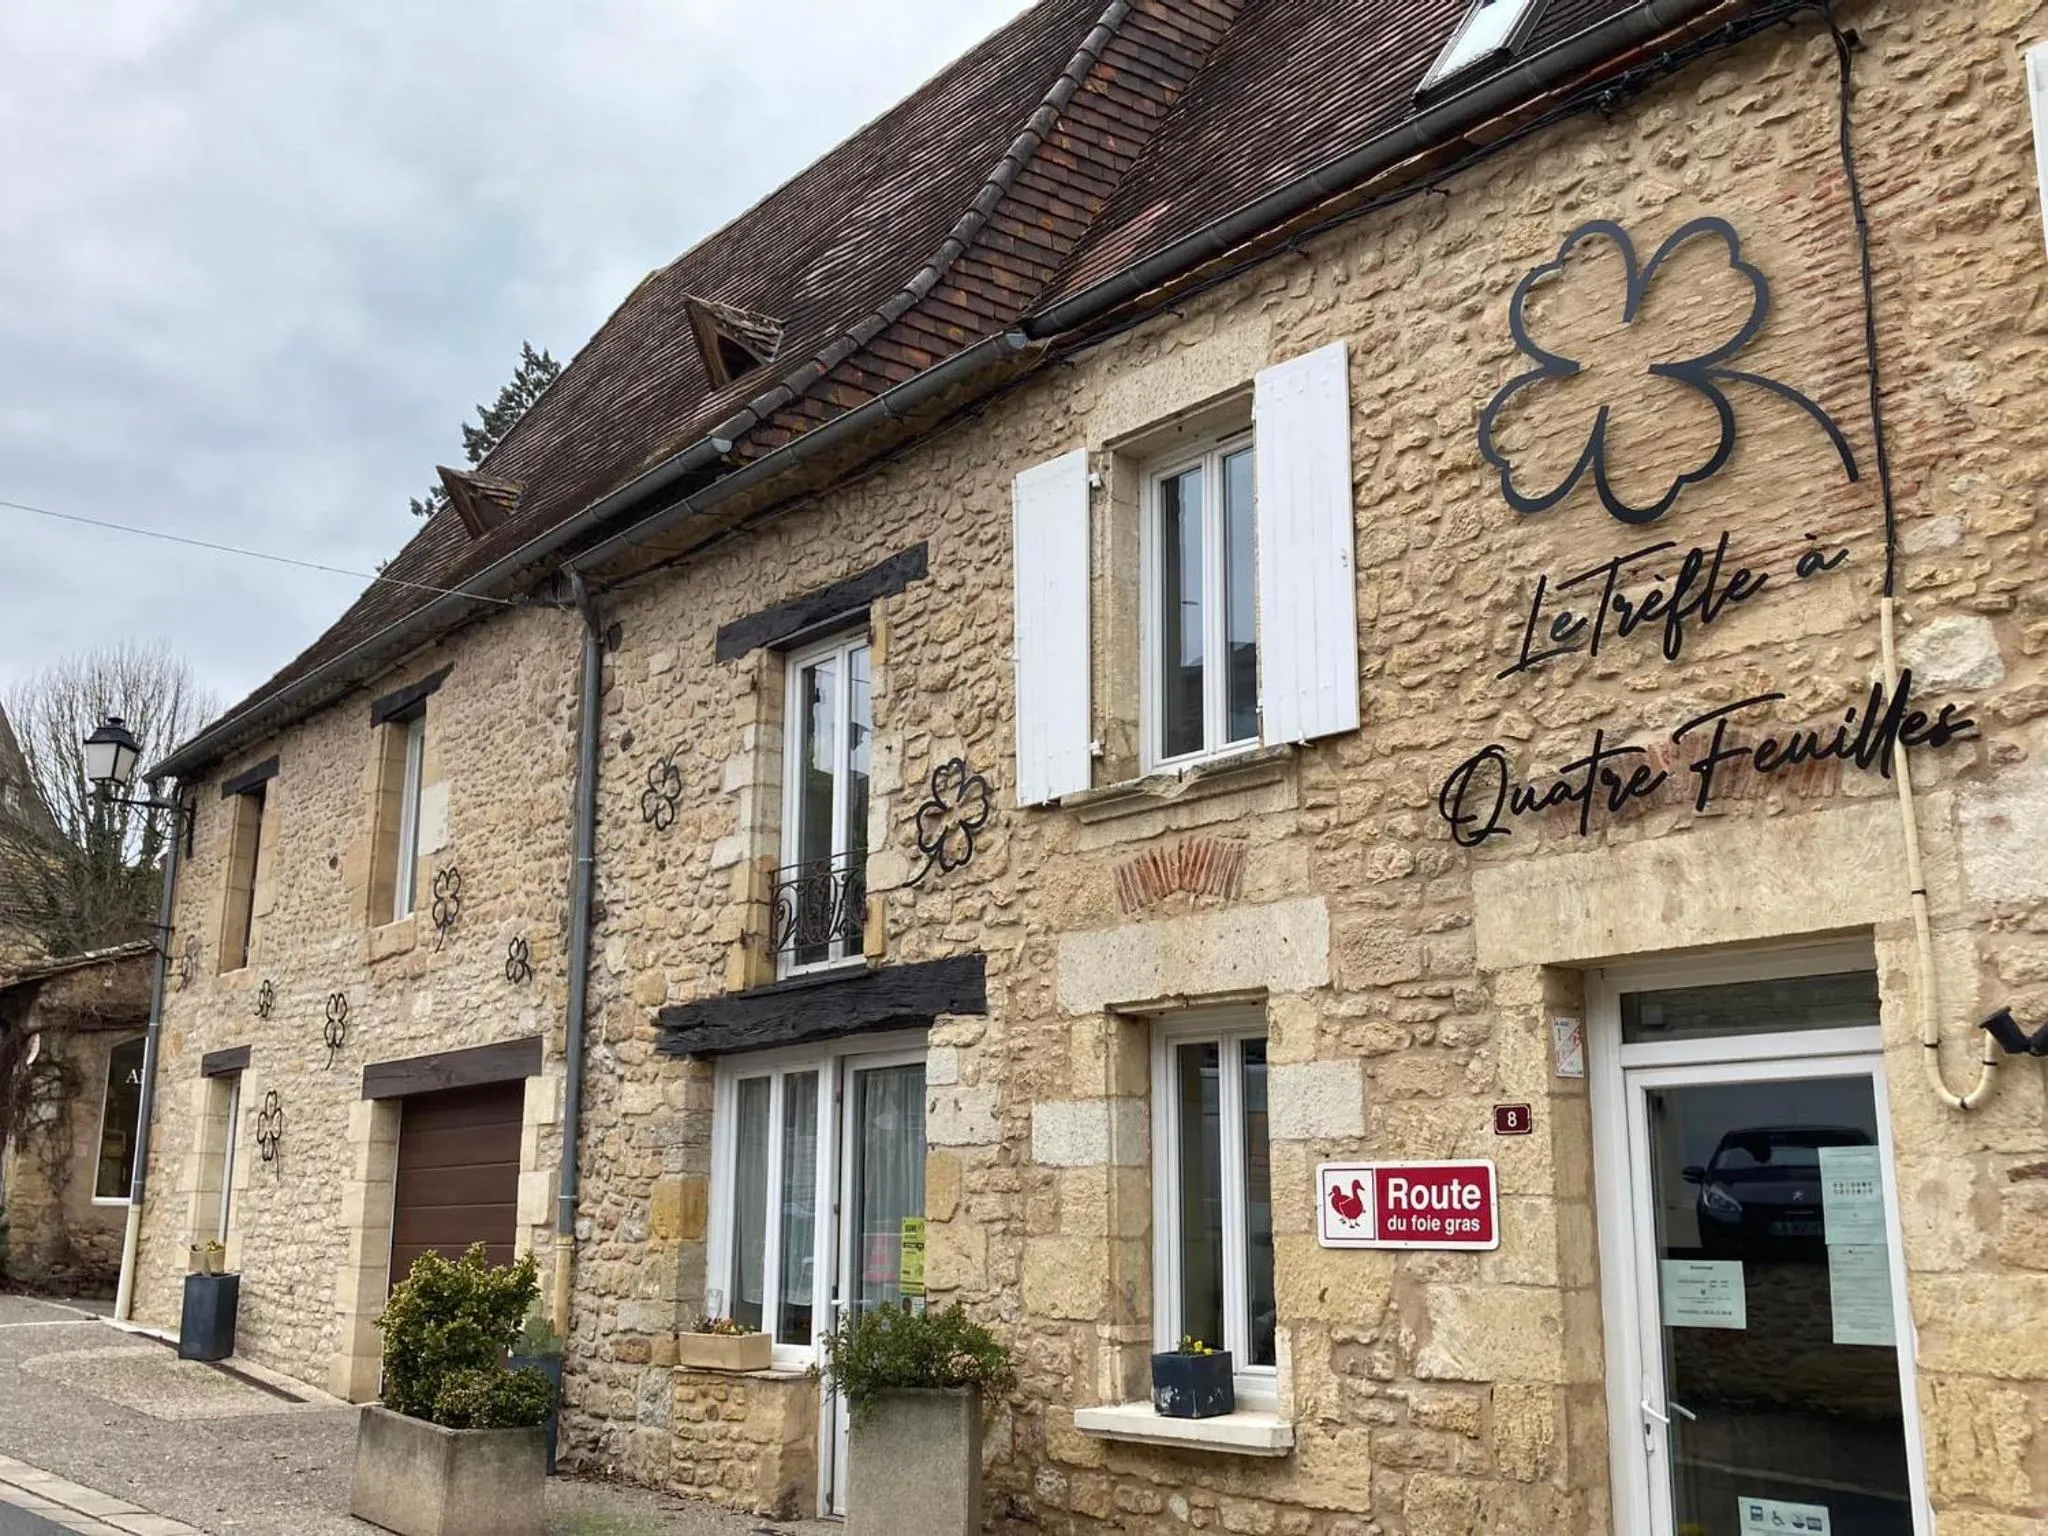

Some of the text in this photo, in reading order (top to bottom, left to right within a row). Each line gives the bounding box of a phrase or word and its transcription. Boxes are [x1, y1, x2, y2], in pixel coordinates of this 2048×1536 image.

[1796, 533, 1850, 578] à
[1438, 668, 1975, 847] Quatre Feuilles
[1506, 1111, 1518, 1128] 8
[1387, 1177, 1482, 1210] Route
[1387, 1214, 1480, 1235] du foie gras
